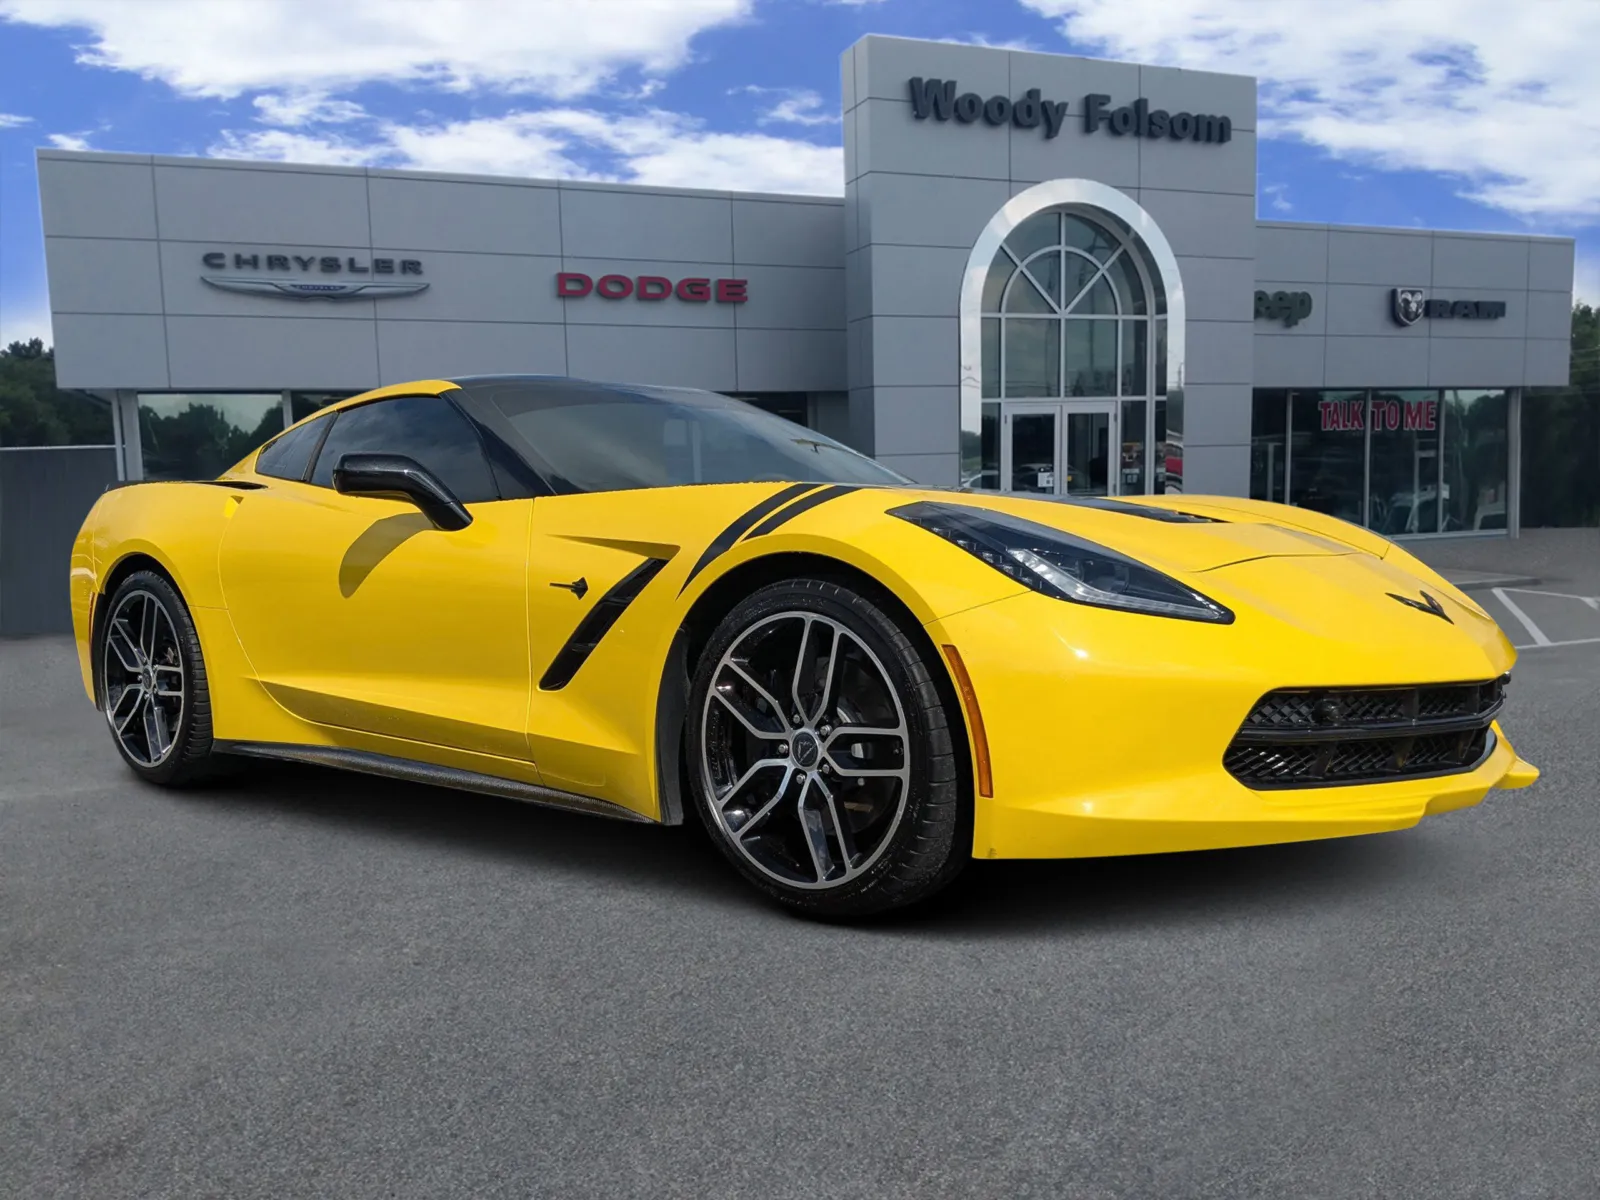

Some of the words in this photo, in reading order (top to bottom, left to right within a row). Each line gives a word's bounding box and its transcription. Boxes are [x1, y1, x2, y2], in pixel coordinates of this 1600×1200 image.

[908, 77, 1069, 139] Woody
[1083, 93, 1232, 143] Folsom
[202, 252, 424, 275] CHRYSLER
[557, 272, 748, 303] DODGE
[1254, 290, 1313, 328] eep
[1424, 299, 1506, 319] RAM
[1318, 400, 1365, 431] TALK
[1371, 400, 1400, 431] TO
[1403, 400, 1437, 431] ME
